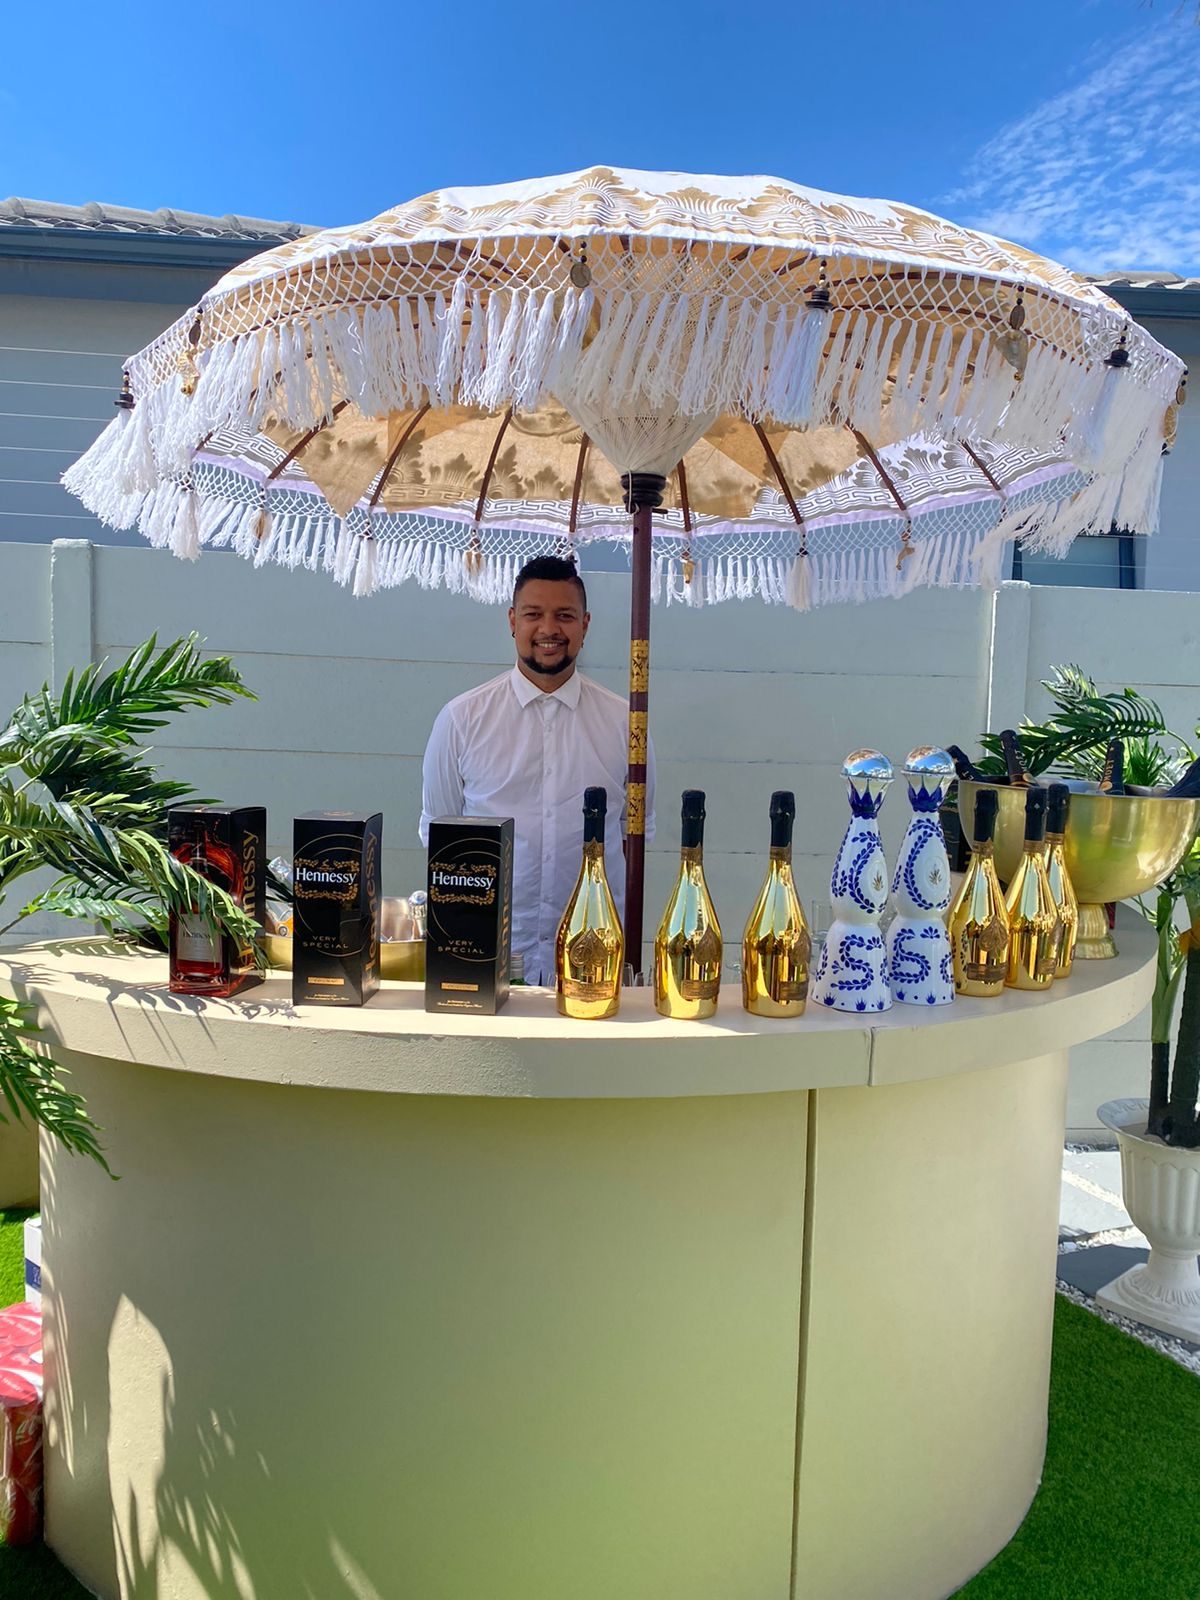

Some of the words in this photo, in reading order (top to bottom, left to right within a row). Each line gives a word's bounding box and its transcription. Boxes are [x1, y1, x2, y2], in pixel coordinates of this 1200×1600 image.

[296, 867, 357, 885] Hennessy
[432, 871, 494, 890] Hennessy
[303, 941, 349, 949] SPECIAL
[438, 946, 485, 954] SPECIAL
